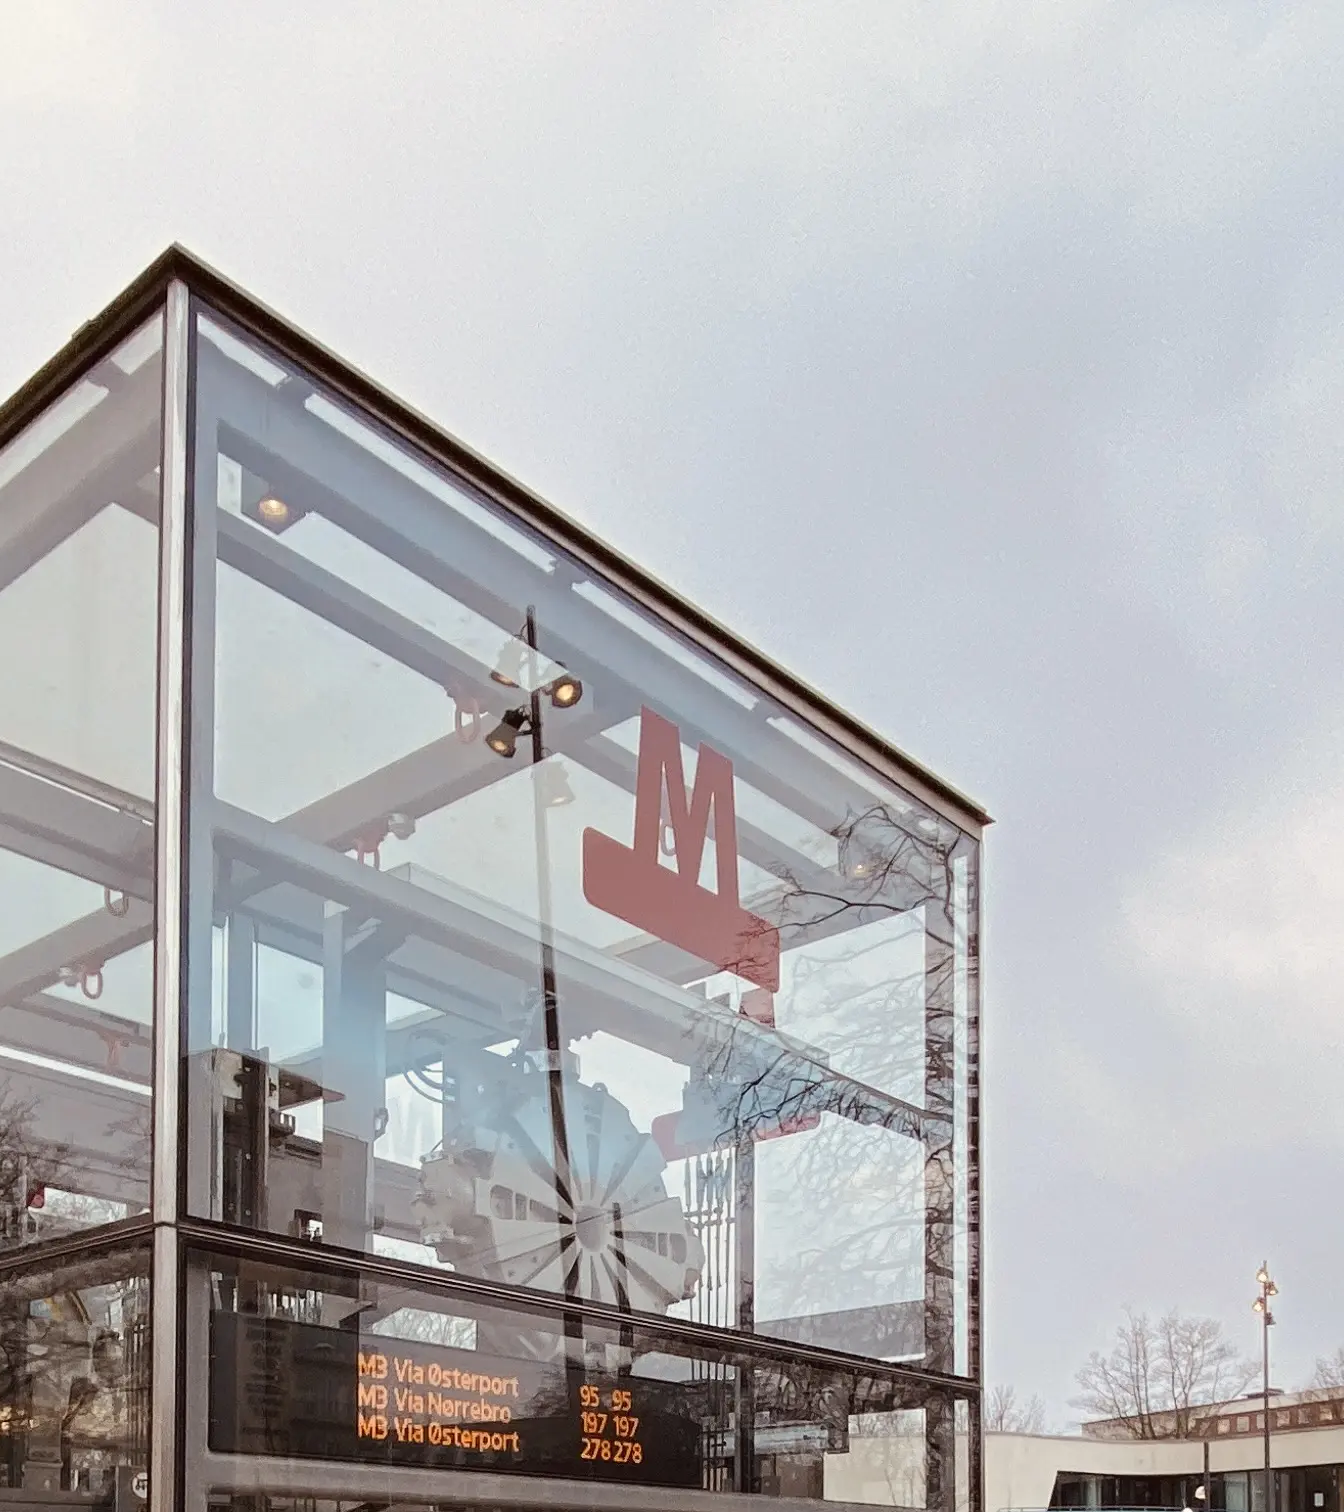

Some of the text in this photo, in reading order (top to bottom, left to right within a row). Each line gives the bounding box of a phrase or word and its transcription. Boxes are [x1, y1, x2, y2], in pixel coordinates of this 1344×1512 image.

[357, 1352, 632, 1411] M3 Via Østerport 95 95
[358, 1382, 639, 1437] M3 Via Nørrebro 197 197
[358, 1412, 642, 1464] M3 Via Østerport 278 278
